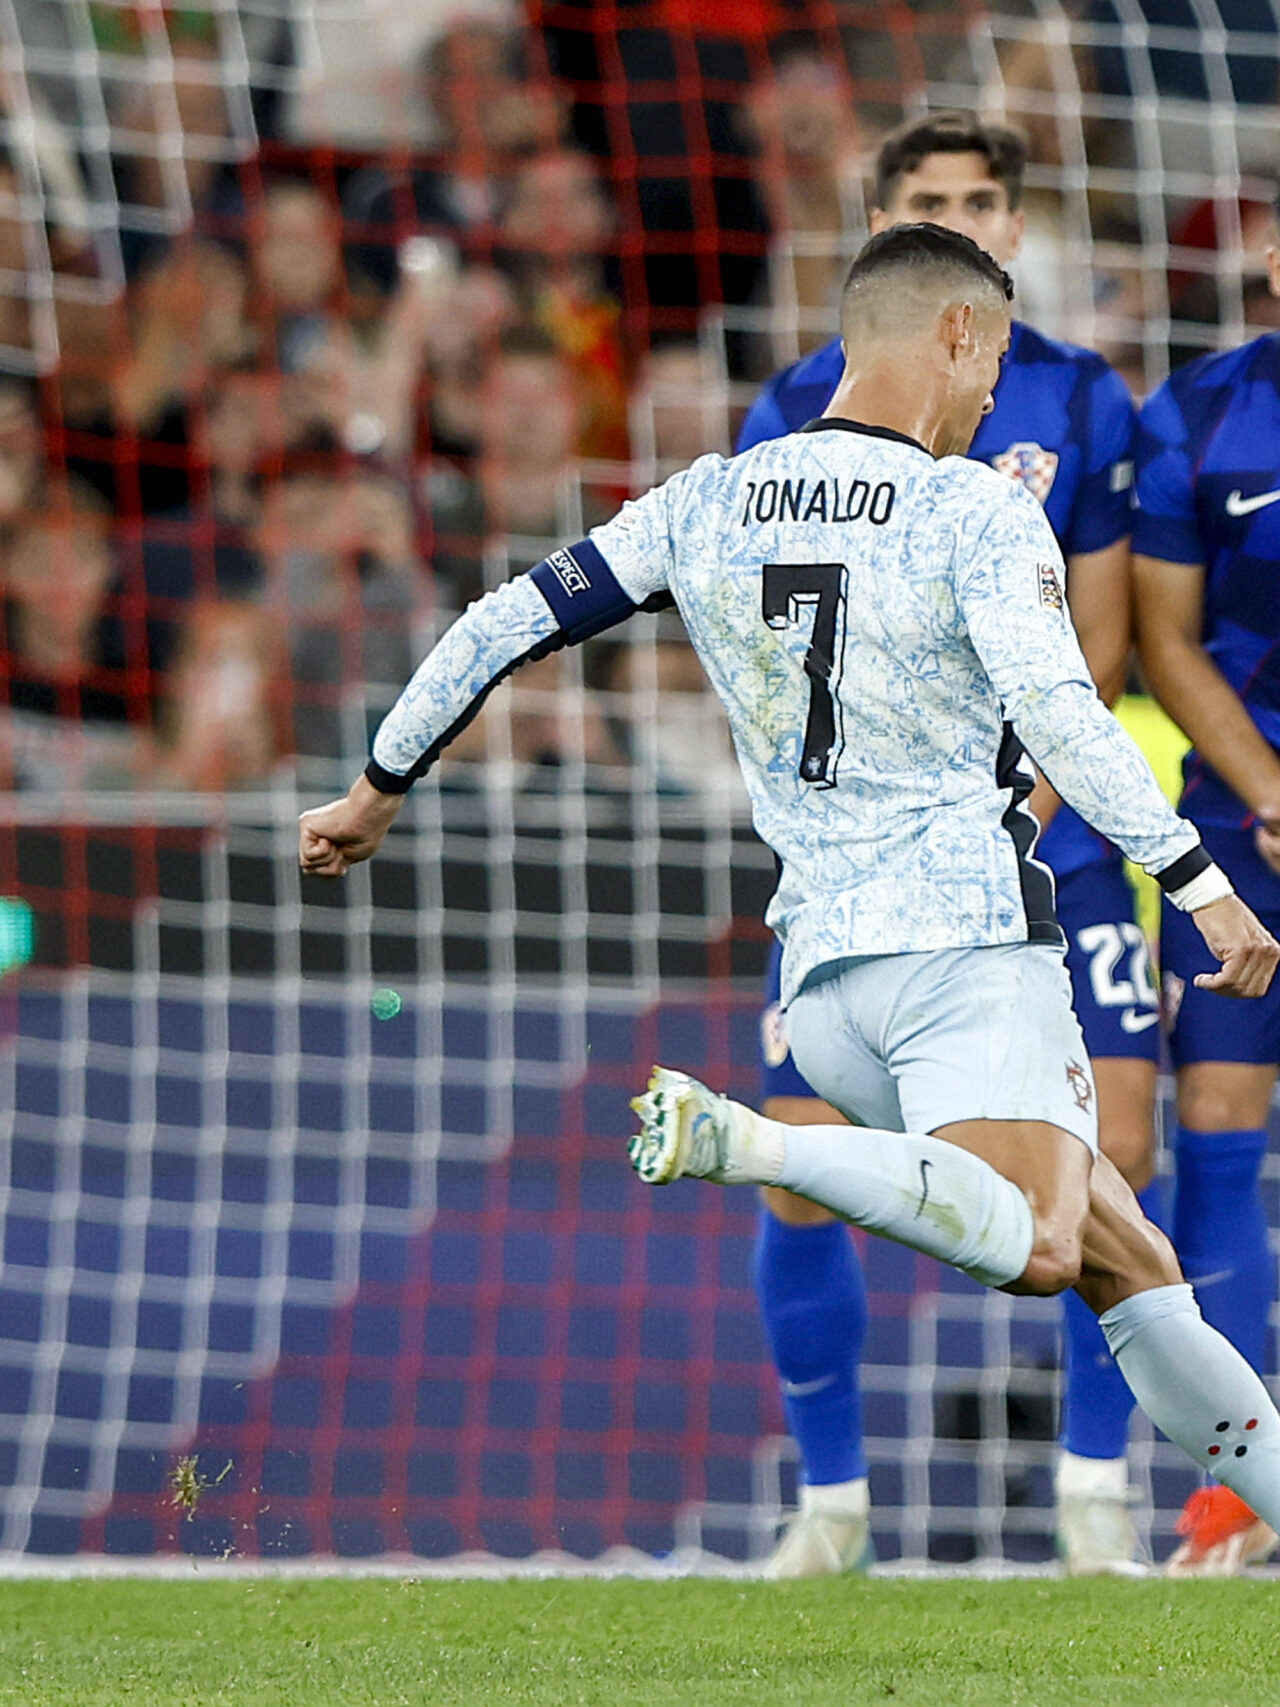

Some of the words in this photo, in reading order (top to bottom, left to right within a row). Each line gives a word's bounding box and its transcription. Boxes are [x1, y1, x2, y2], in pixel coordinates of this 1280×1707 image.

[549, 549, 587, 592] ESPECT
[762, 563, 849, 791] 7
[1077, 921, 1159, 1007] 22
